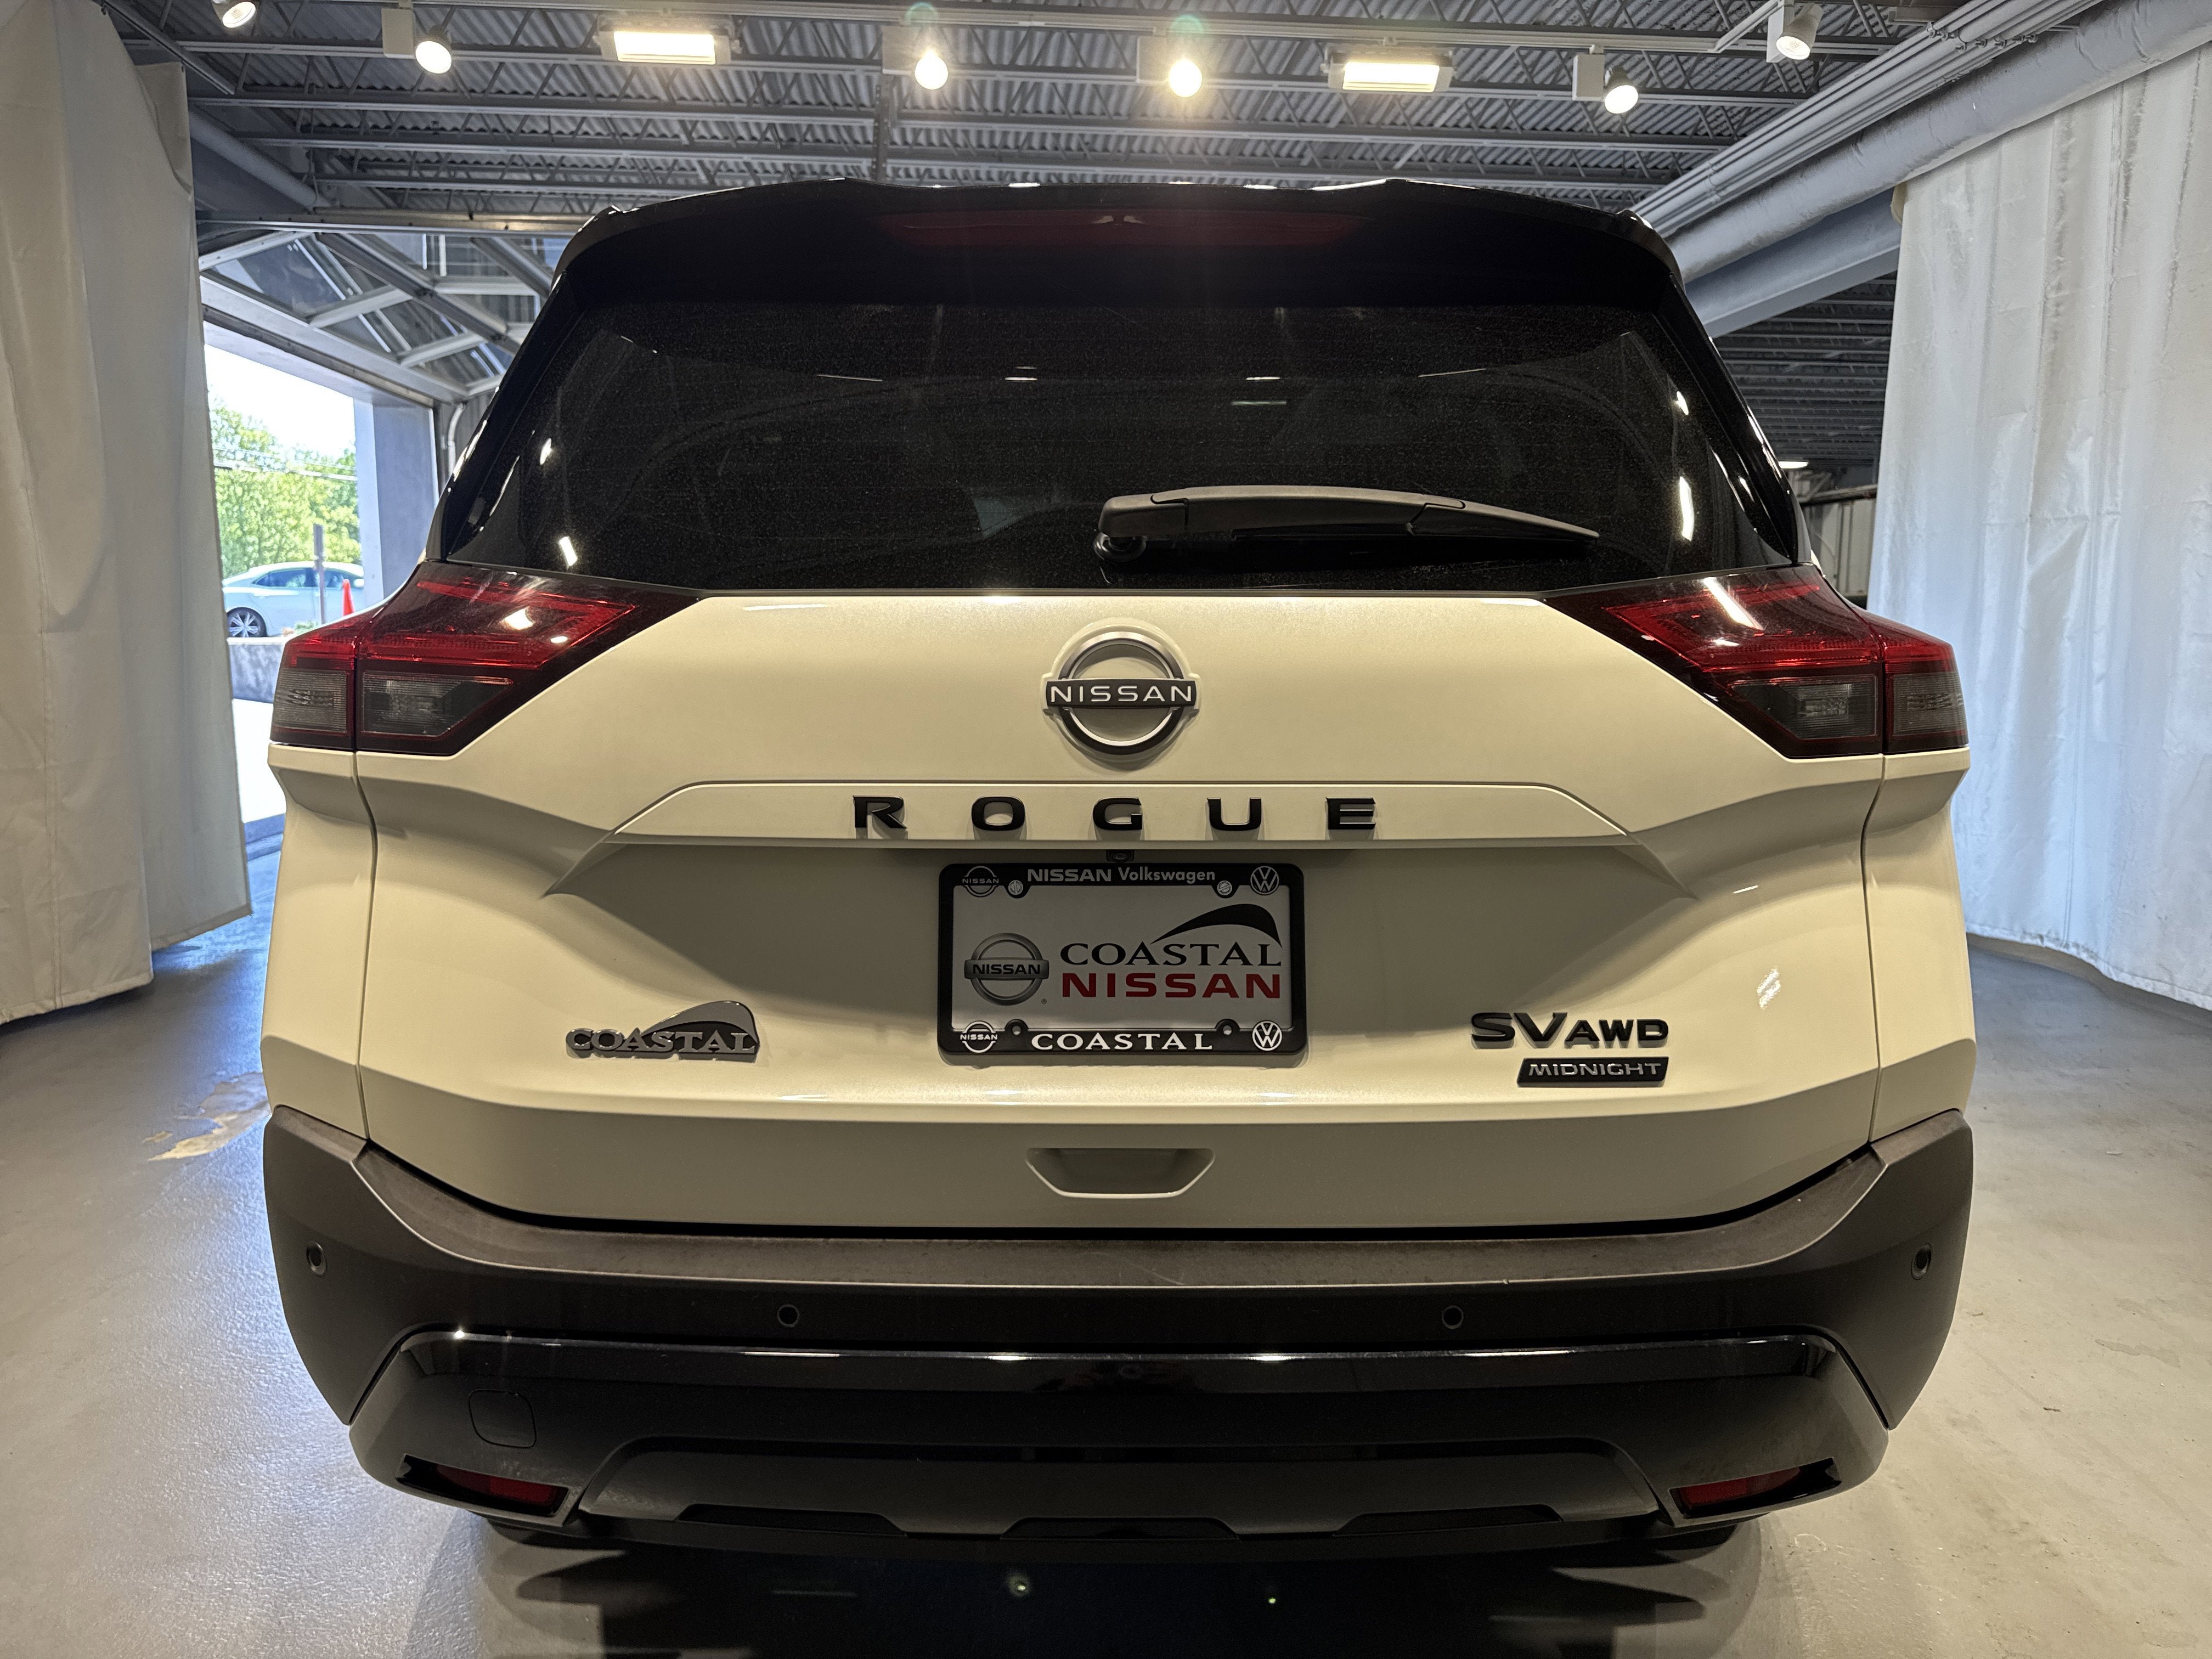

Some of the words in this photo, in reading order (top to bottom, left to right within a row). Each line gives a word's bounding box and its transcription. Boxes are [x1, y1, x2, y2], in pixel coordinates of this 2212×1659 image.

[1051, 686, 1192, 702] NISSAN
[853, 795, 1376, 831] ROGUE
[1028, 868, 1111, 882] NISSAN
[1118, 866, 1215, 884] Volkswagen
[1060, 942, 1282, 967] COASTAL
[973, 964, 1041, 975] NISSAN
[1062, 973, 1280, 998] NISSAN
[566, 1028, 758, 1054] COASTAL
[1031, 1032, 1212, 1051] COASTAL
[1528, 1063, 1661, 1076] MIDNIGHT
